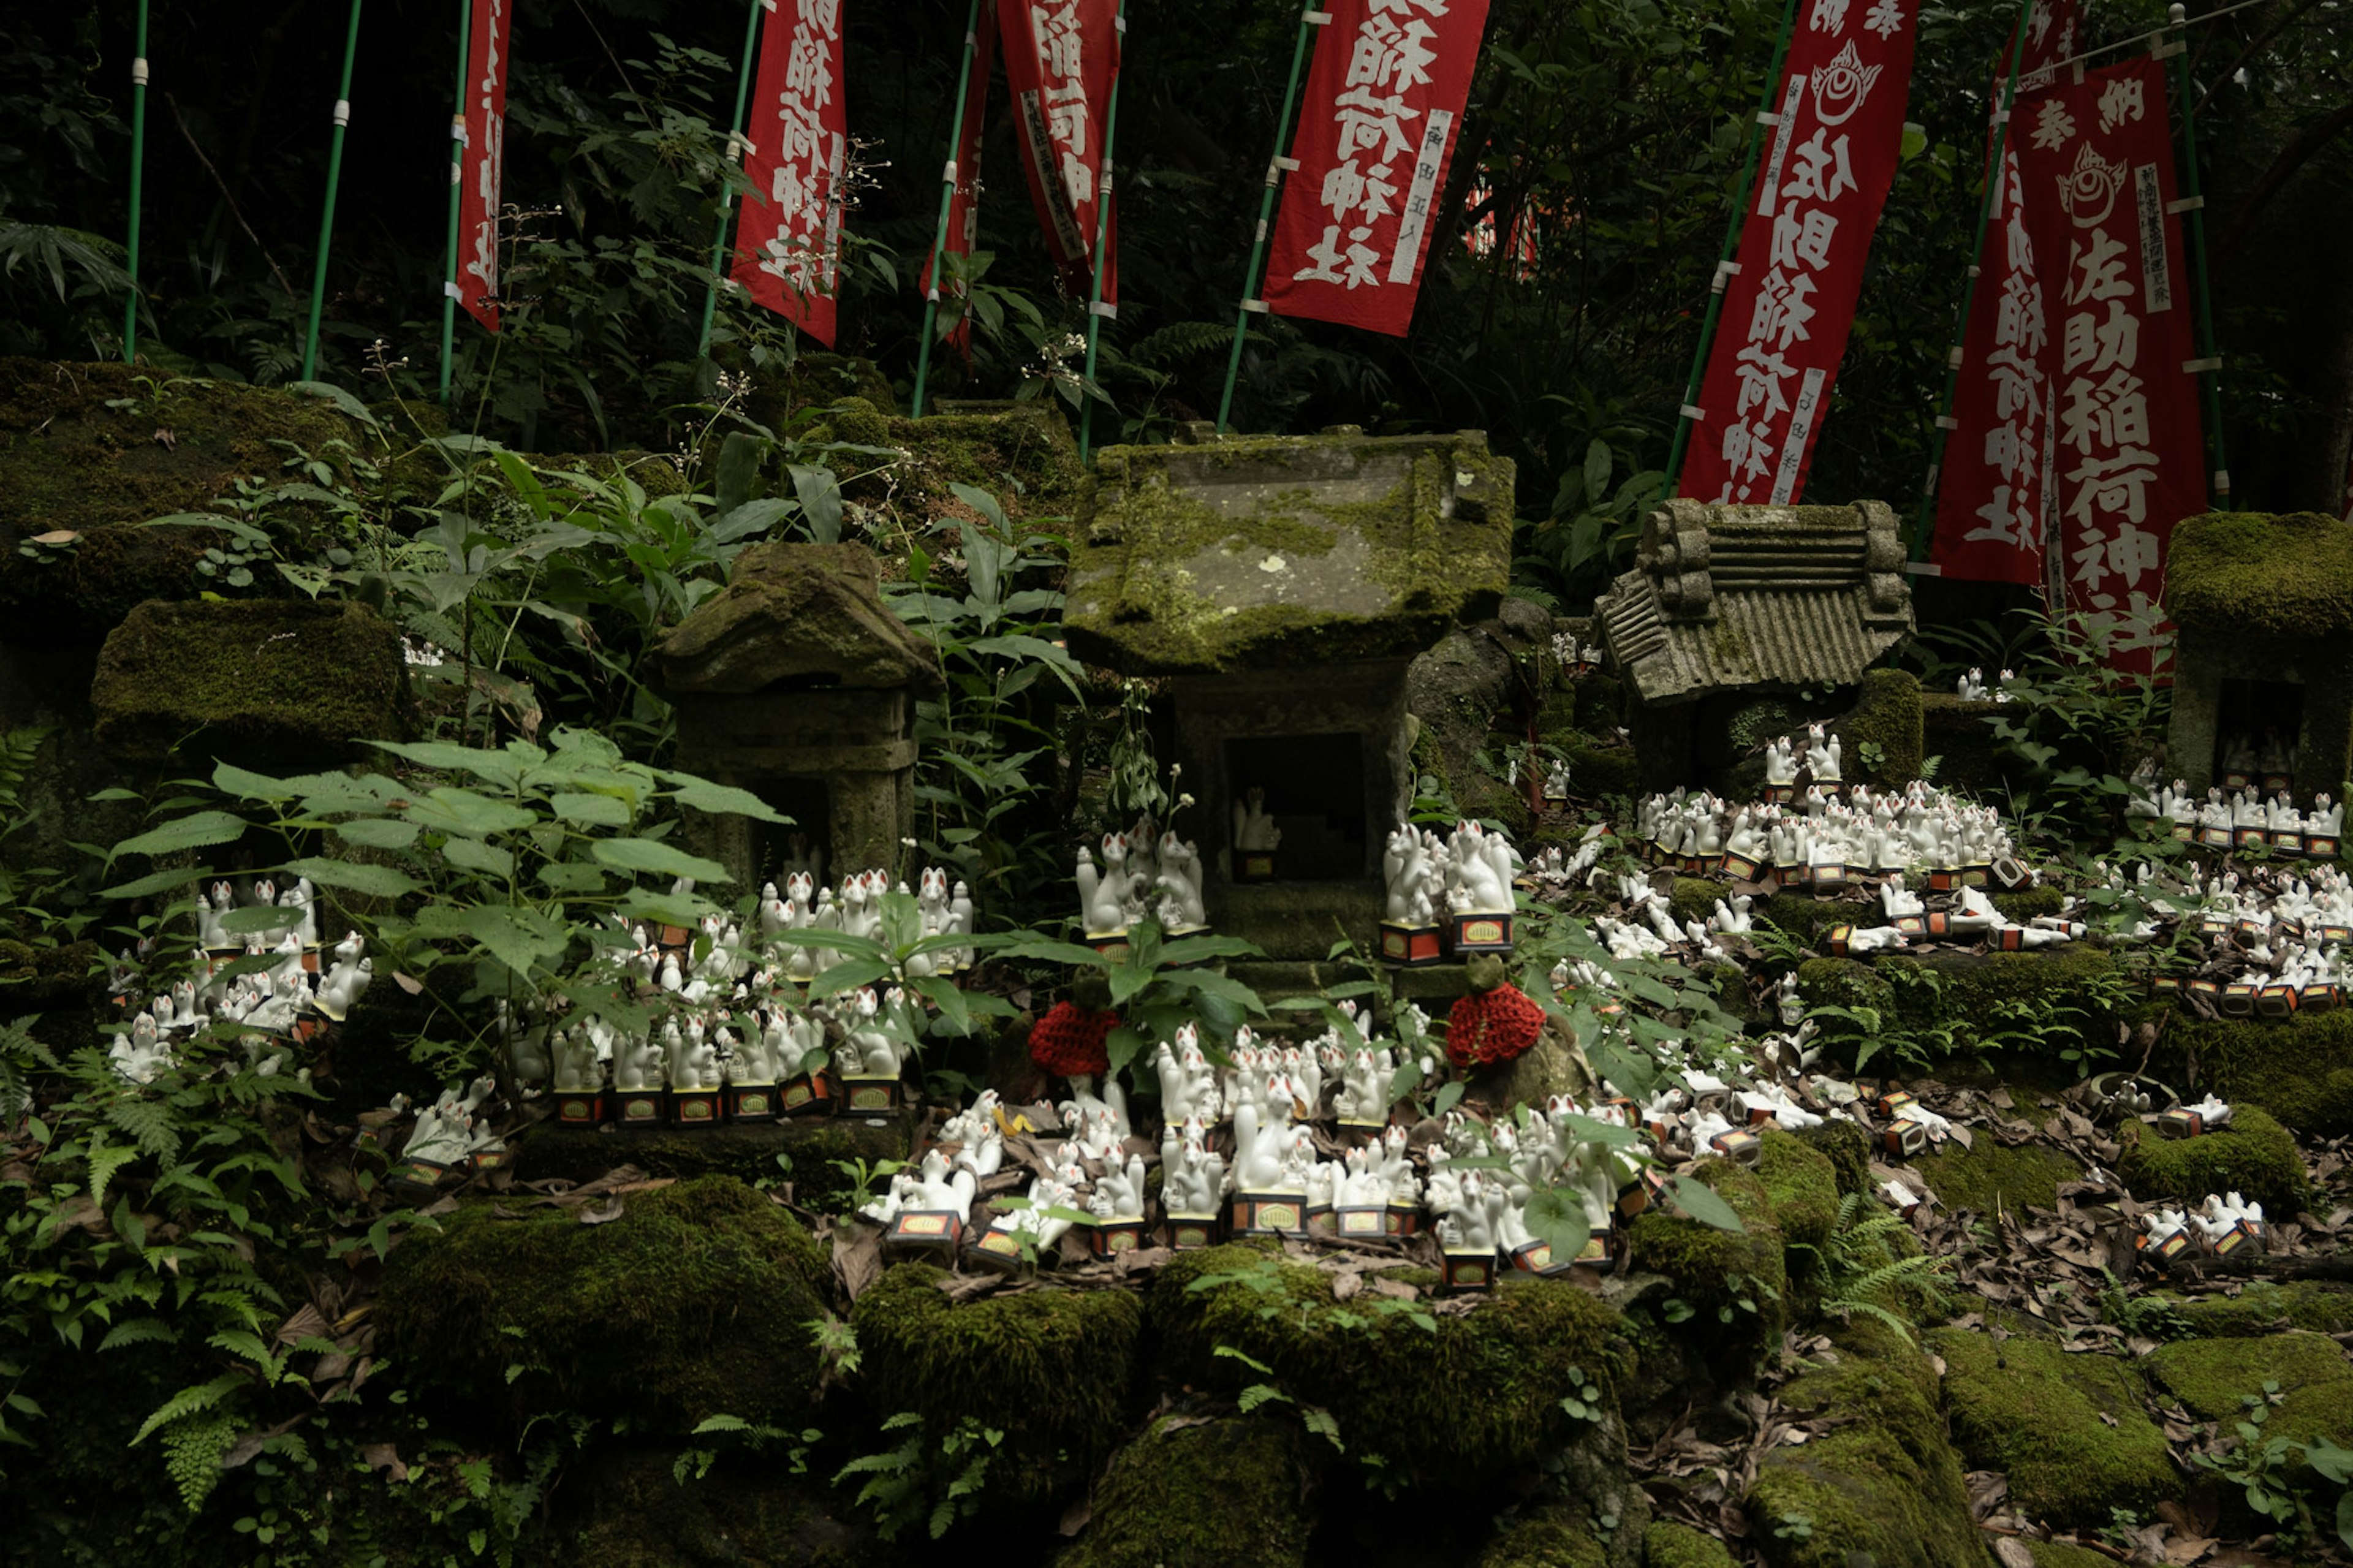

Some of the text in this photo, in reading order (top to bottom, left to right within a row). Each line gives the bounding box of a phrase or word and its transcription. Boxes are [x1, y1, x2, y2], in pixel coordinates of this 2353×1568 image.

[2029, 77, 2145, 153] 奉納
[2059, 228, 2177, 657] 佐助稲荷神社
